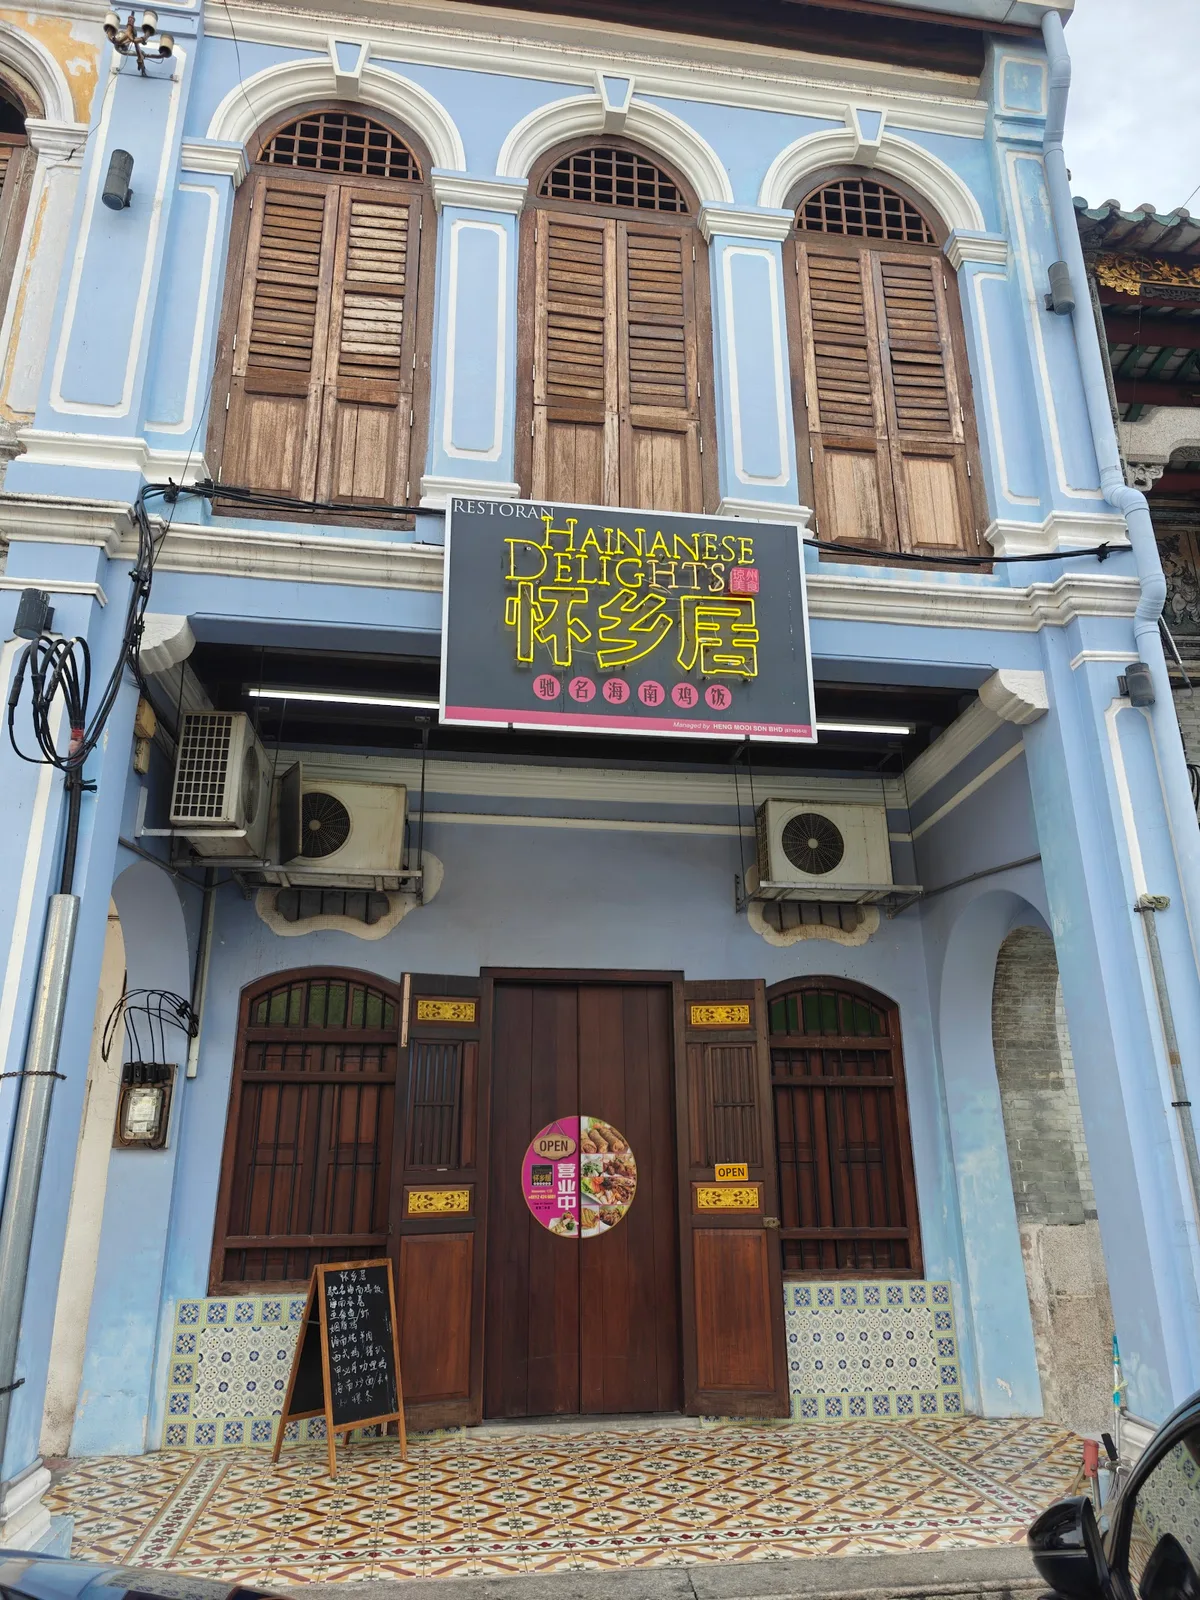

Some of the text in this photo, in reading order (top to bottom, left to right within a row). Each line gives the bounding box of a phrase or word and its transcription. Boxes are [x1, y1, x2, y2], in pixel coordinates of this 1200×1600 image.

[453, 499, 554, 520] RESTORAN
[541, 516, 755, 565] HAINANESE
[504, 538, 725, 592] DELIGHTS
[505, 582, 760, 677] 怀乡居
[539, 678, 725, 706] 驰名海南鸡饭
[673, 721, 701, 730] Managed
[702, 723, 710, 731] by
[540, 1140, 568, 1152] OPEN
[718, 1167, 745, 1177] OPEN
[557, 1163, 576, 1211] 营业中
